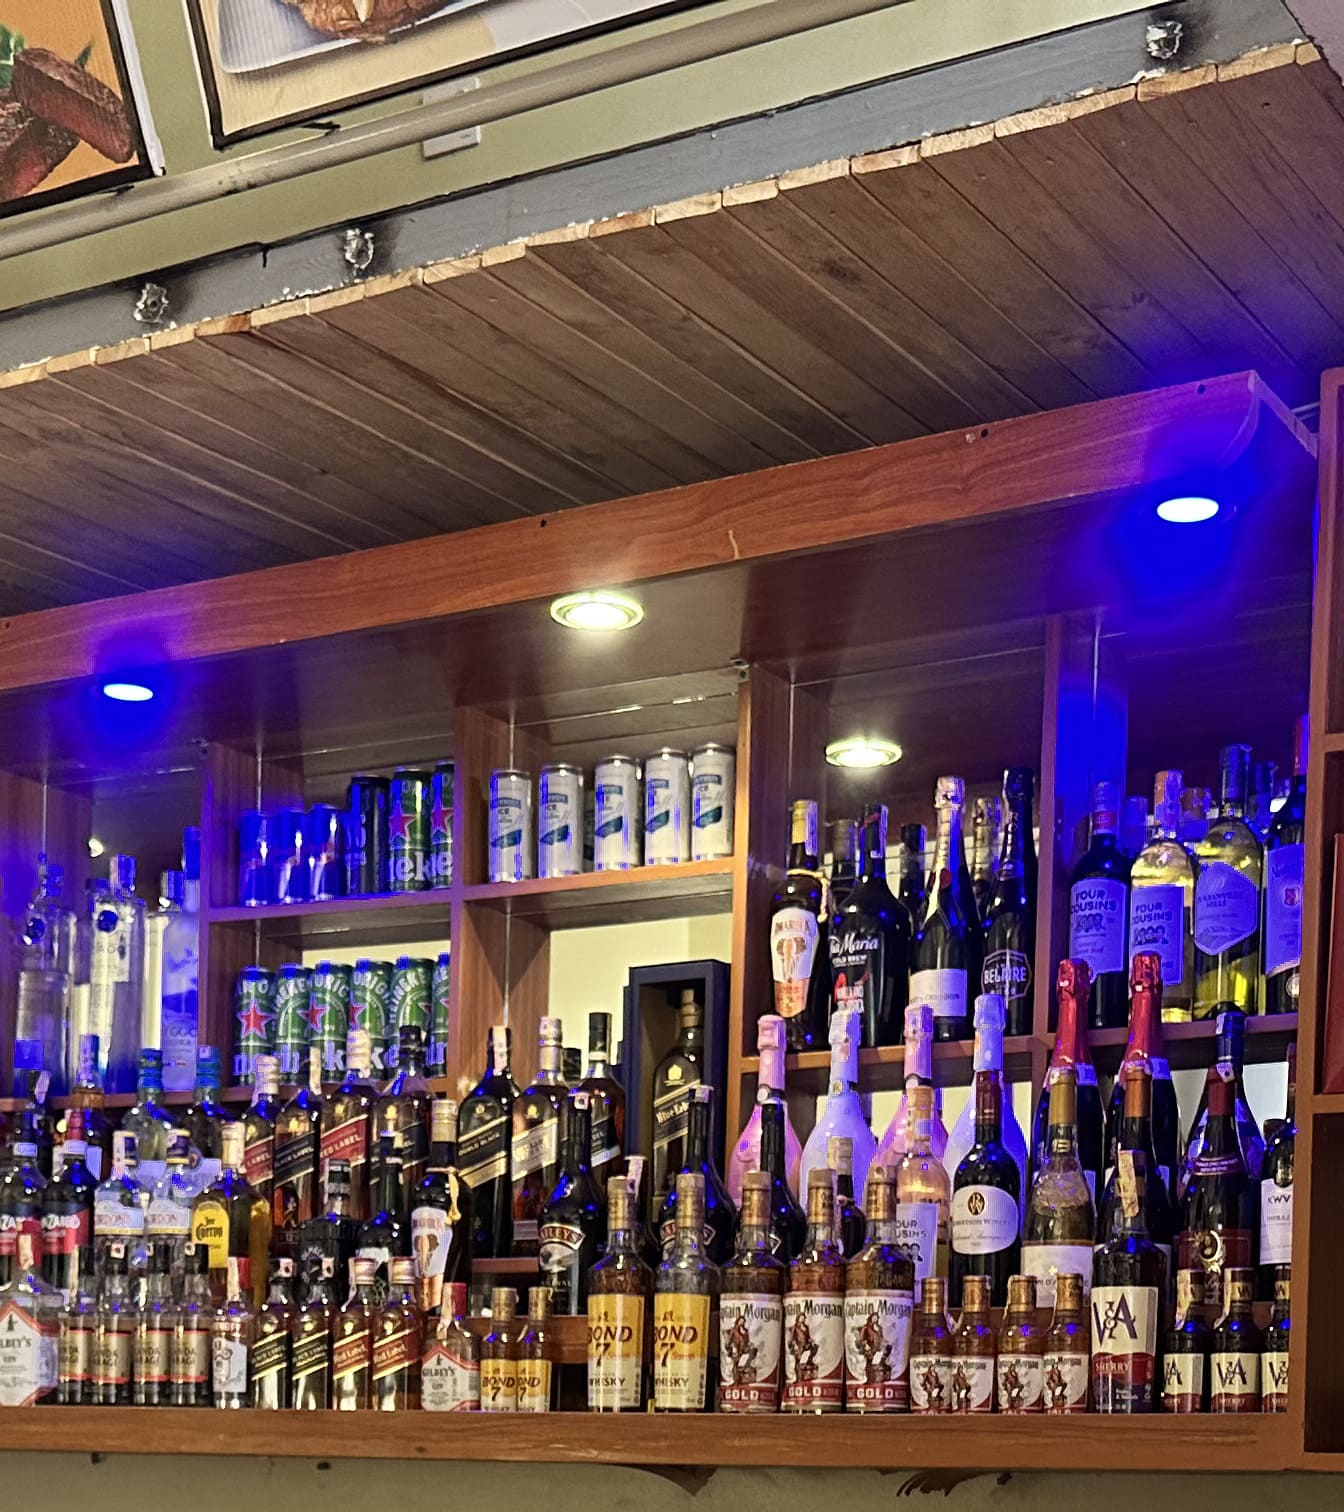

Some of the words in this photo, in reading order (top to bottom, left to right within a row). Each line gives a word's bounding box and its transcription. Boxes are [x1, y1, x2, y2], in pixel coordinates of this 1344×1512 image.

[838, 935, 879, 954] Maria
[334, 1133, 362, 1152] LABEL
[744, 1303, 781, 1322] Morgan
[805, 1299, 843, 1318] Morgan
[594, 1342, 612, 1368] 7
[659, 1342, 675, 1369] 7
[481, 1376, 516, 1389] BOND
[788, 1386, 822, 1398] GOLD
[490, 1387, 502, 1402] 7
[724, 1389, 759, 1401] GOLD
[856, 1387, 895, 1400] GOLD
